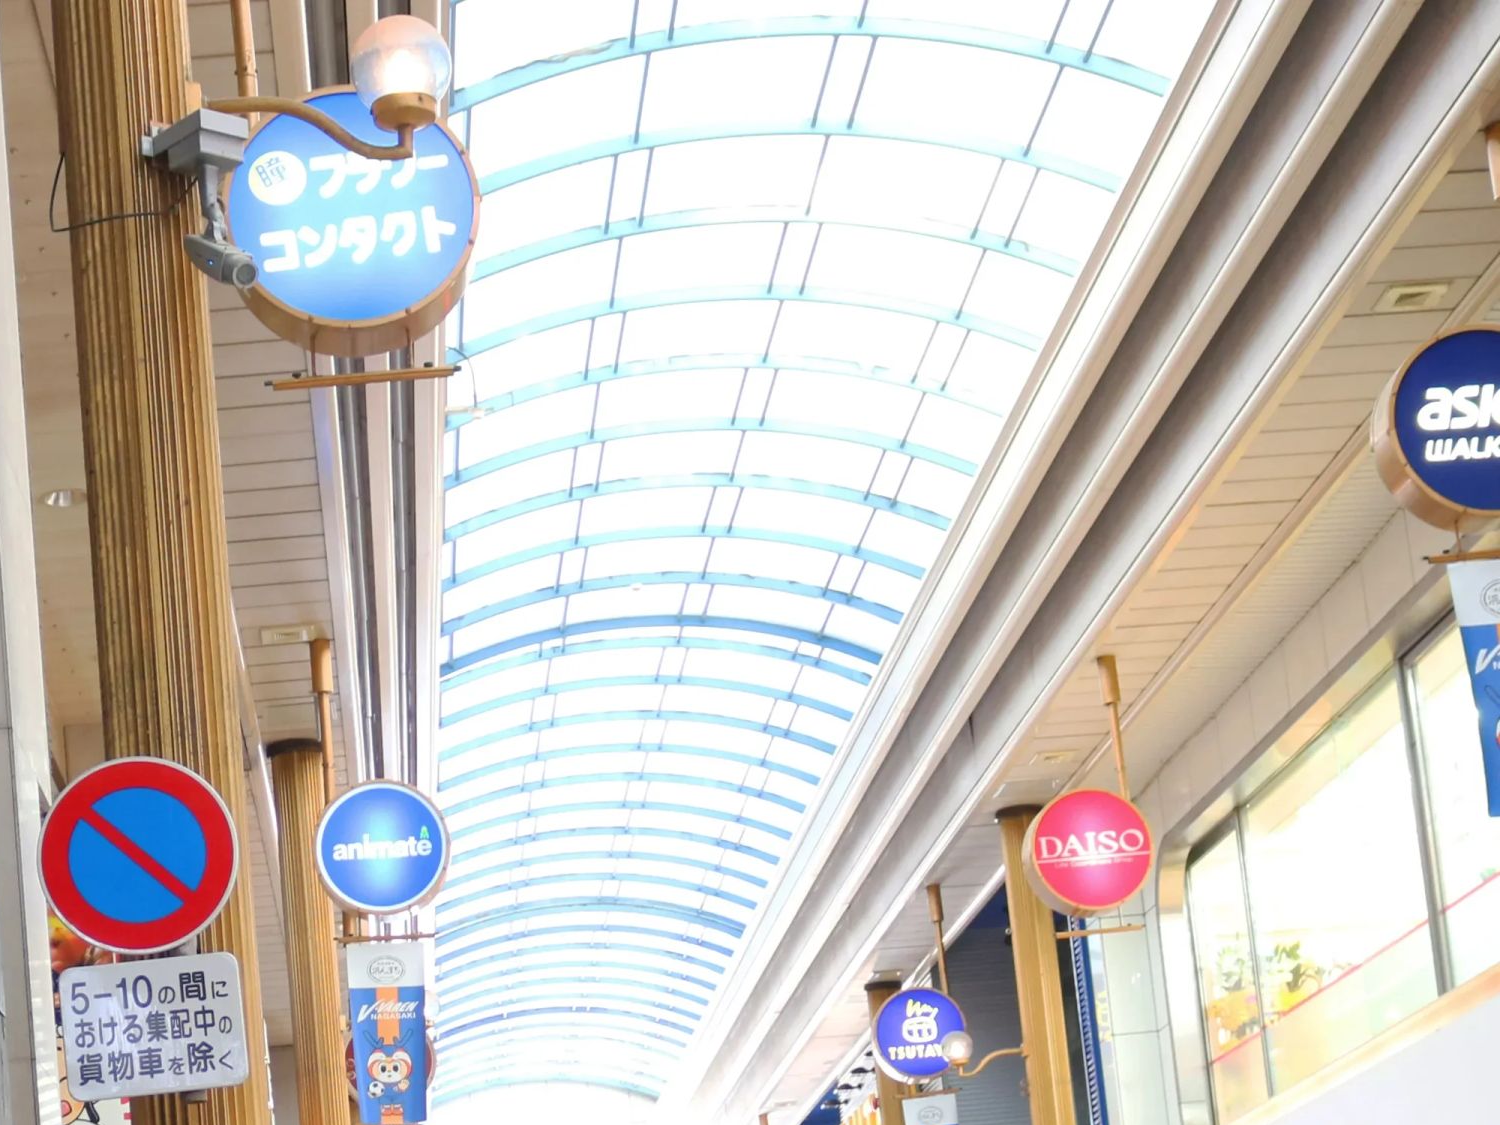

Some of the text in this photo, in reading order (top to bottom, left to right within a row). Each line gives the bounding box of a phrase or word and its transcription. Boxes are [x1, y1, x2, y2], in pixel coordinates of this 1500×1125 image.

[259, 205, 457, 273] コンタクト
[332, 832, 433, 863] animate
[1038, 828, 1145, 859] DAISO
[74, 1008, 234, 1047] おける集配中の
[370, 1011, 417, 1021] NAGASAKI
[77, 1042, 236, 1086] 貨物車を除く
